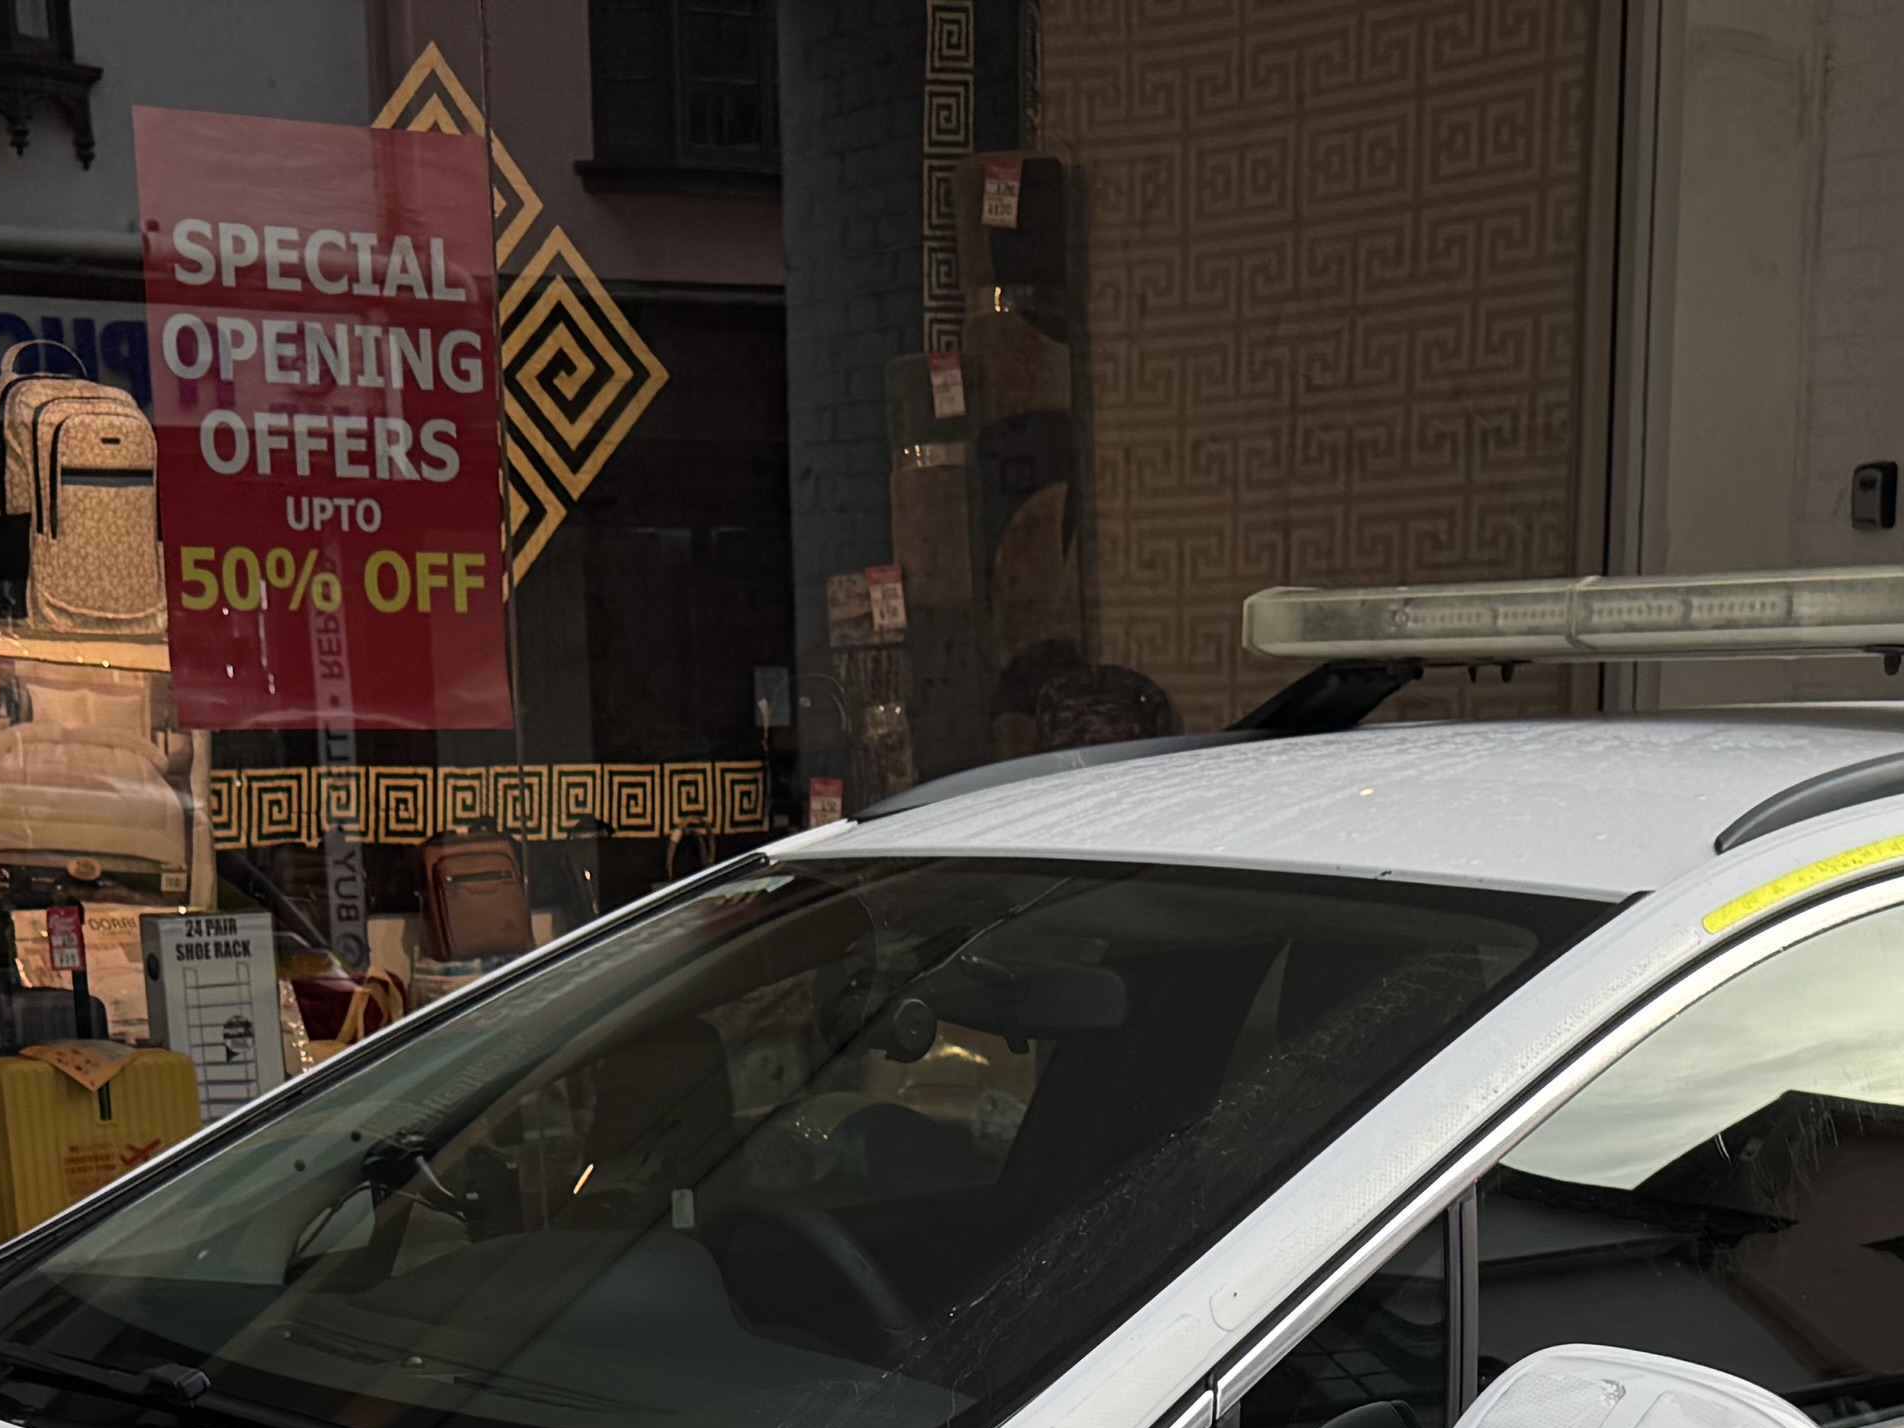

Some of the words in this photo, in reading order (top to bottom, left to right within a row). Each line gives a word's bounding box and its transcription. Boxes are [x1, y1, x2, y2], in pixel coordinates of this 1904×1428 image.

[173, 217, 468, 302] SPECIAL
[162, 312, 484, 395] OPENING
[199, 409, 461, 484] OFFERS
[286, 495, 382, 533] UPTO
[181, 545, 343, 613] 50%
[363, 552, 486, 613] OFF
[175, 942, 212, 962] SHOE
[214, 939, 252, 959] RACK
[185, 919, 203, 938] 24
[205, 917, 238, 937] PAIR
